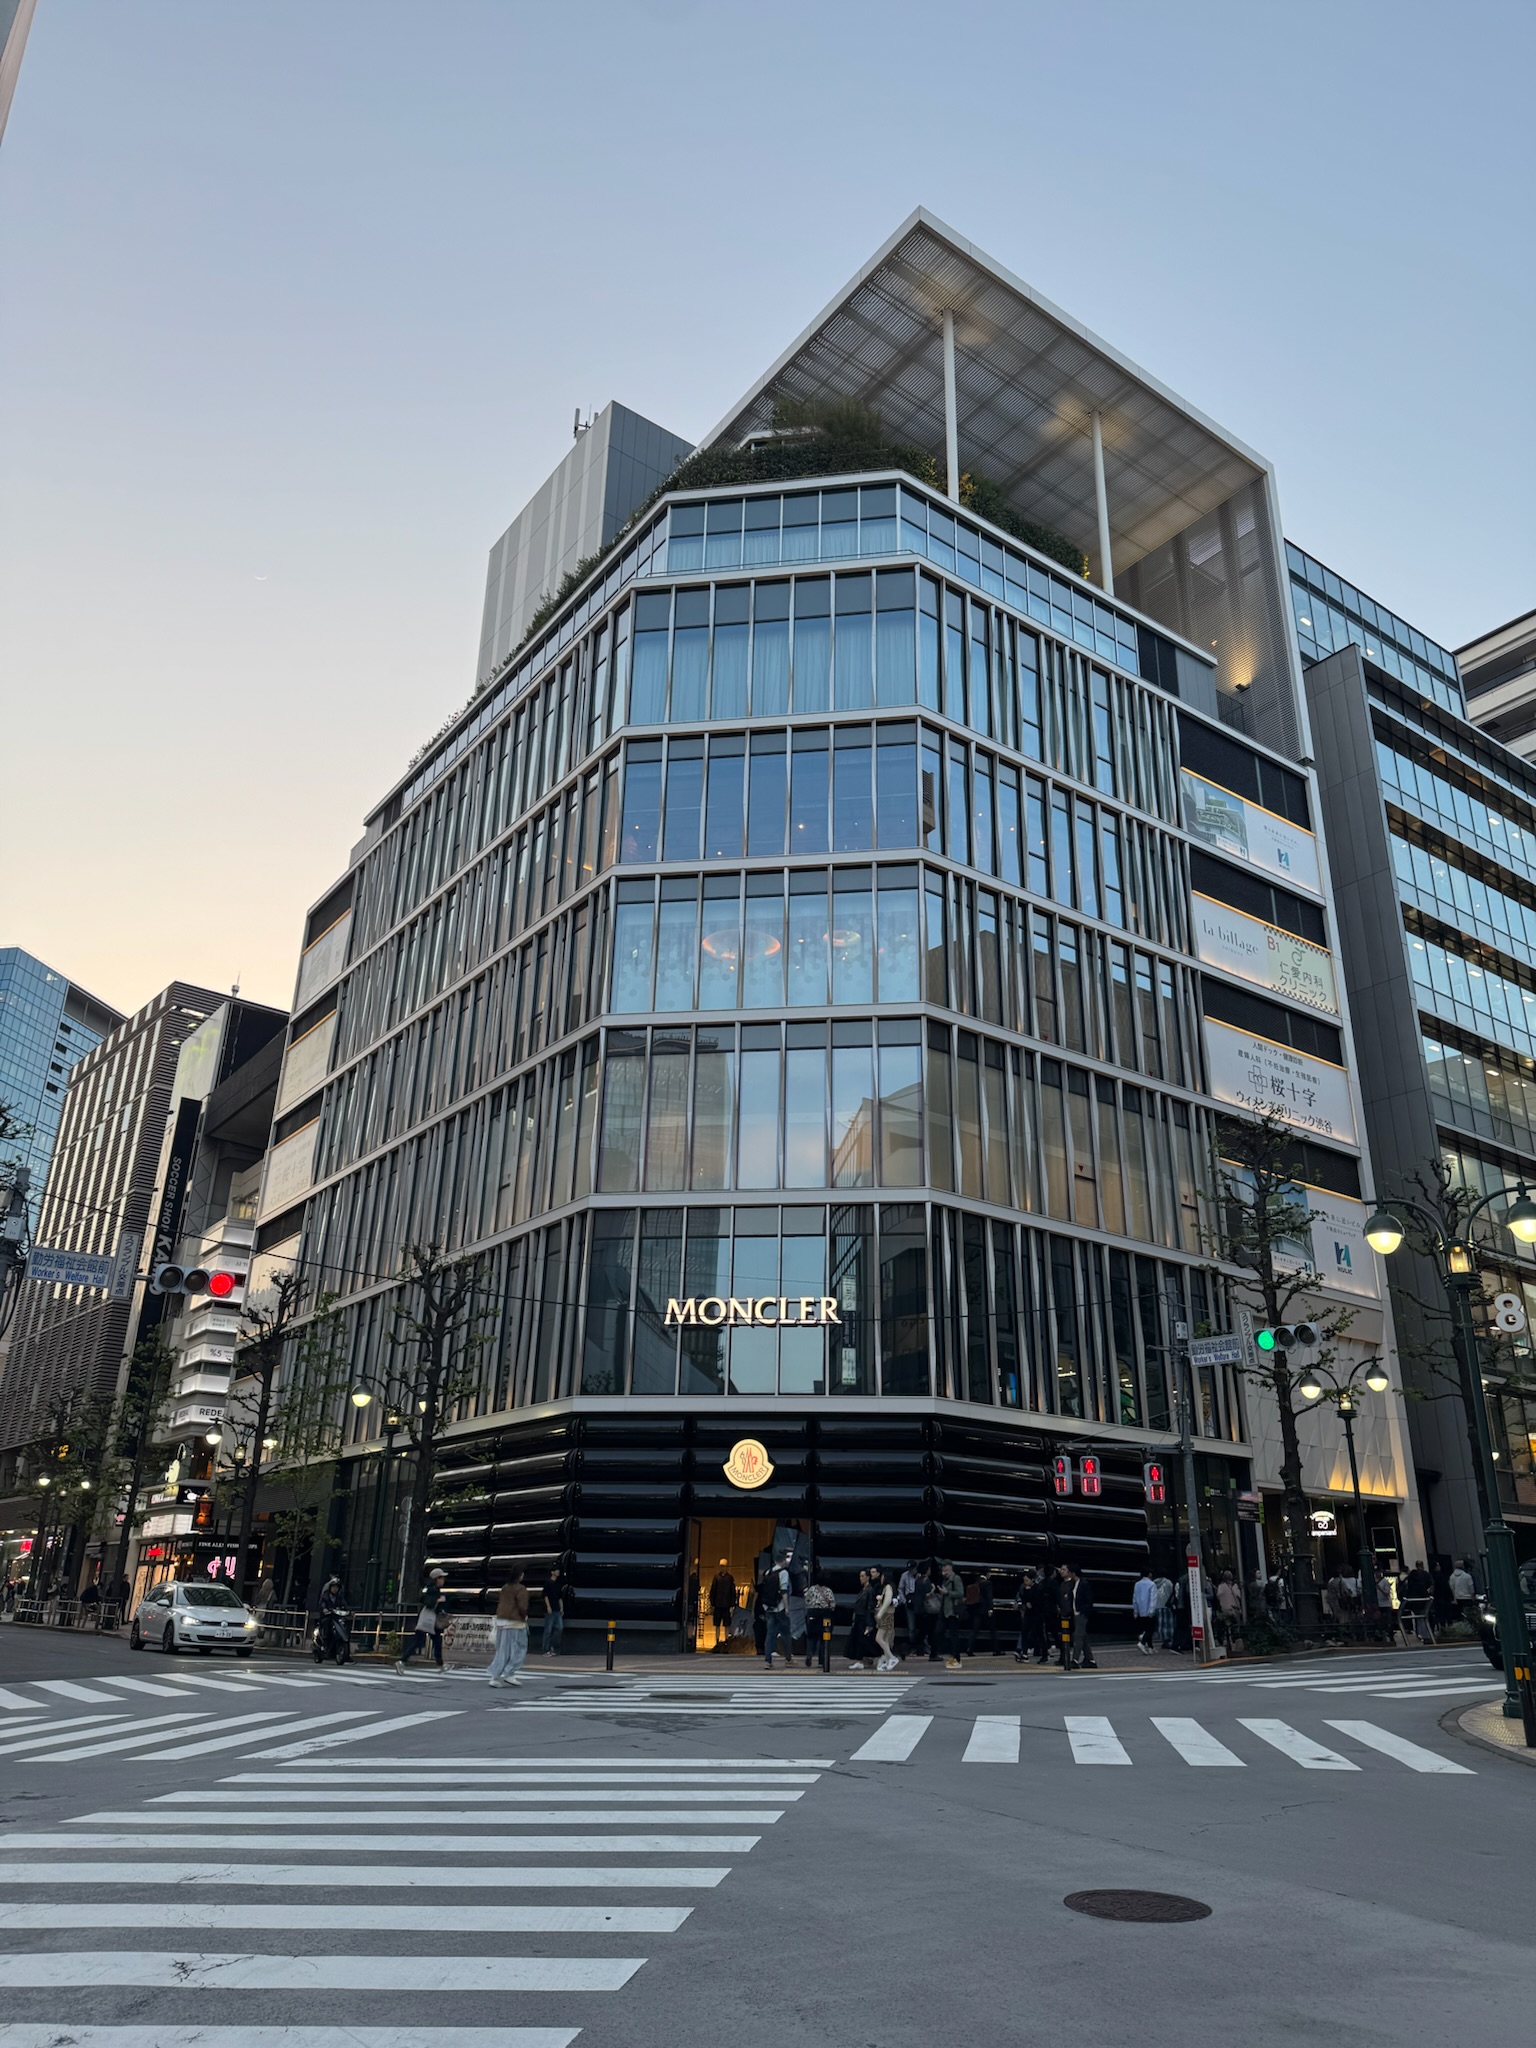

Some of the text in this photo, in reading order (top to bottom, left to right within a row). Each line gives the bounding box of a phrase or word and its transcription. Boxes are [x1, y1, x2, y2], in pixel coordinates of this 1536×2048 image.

[1202, 919, 1259, 956] la billage
[1267, 935, 1280, 953] B1
[1279, 975, 1327, 1002] クリニック
[1280, 961, 1324, 990] 仁愛内科
[1270, 1075, 1317, 1107] 桜十字
[165, 1155, 182, 1200] SOCCER
[31, 1251, 110, 1275] 勤労福祉会館前
[31, 1265, 106, 1285] Worker's Welfare Hall
[114, 1235, 135, 1296] スクランブル交差点
[663, 1296, 843, 1327] MONCLER
[1494, 1292, 1526, 1333] 8
[730, 1466, 766, 1482] MONCLER
